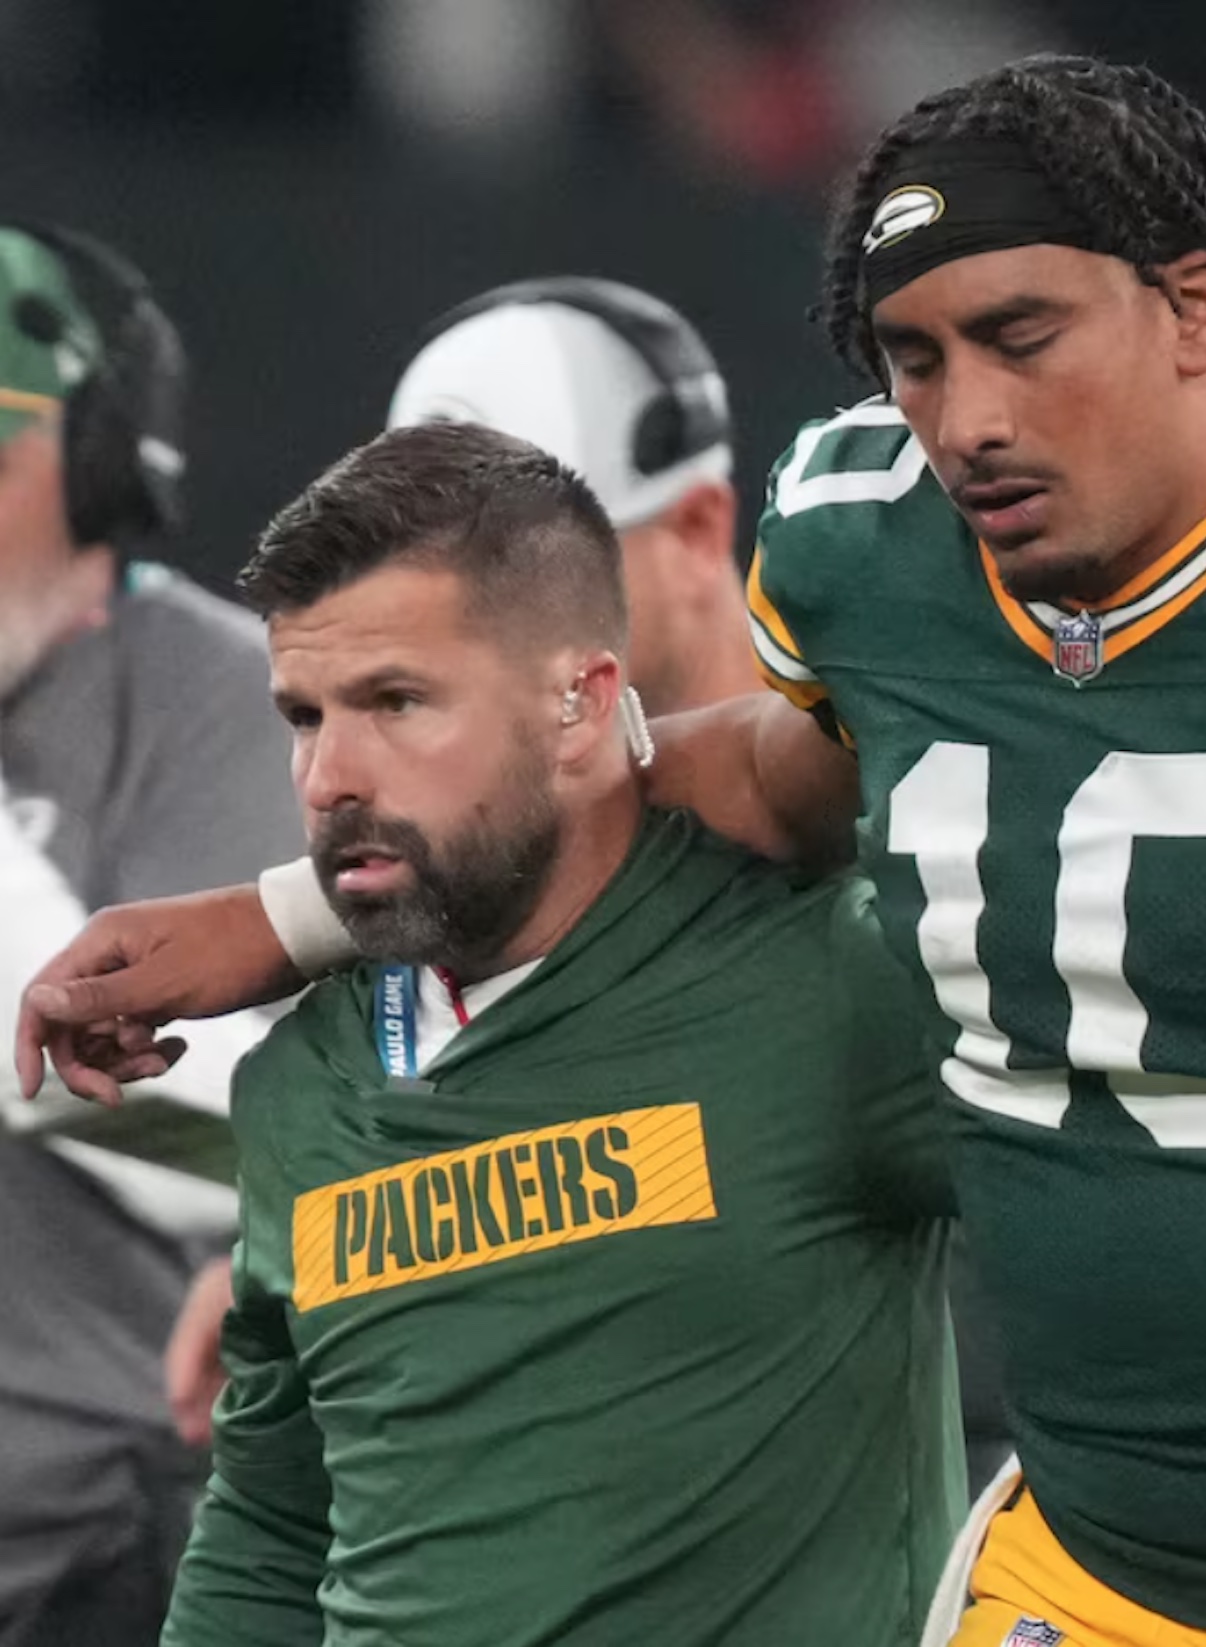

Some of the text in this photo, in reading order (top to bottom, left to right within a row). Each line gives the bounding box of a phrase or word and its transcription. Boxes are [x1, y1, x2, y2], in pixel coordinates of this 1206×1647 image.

[1060, 644, 1092, 674] NFL
[385, 974, 403, 1014] GAME
[334, 1126, 638, 1287] PACKERS
